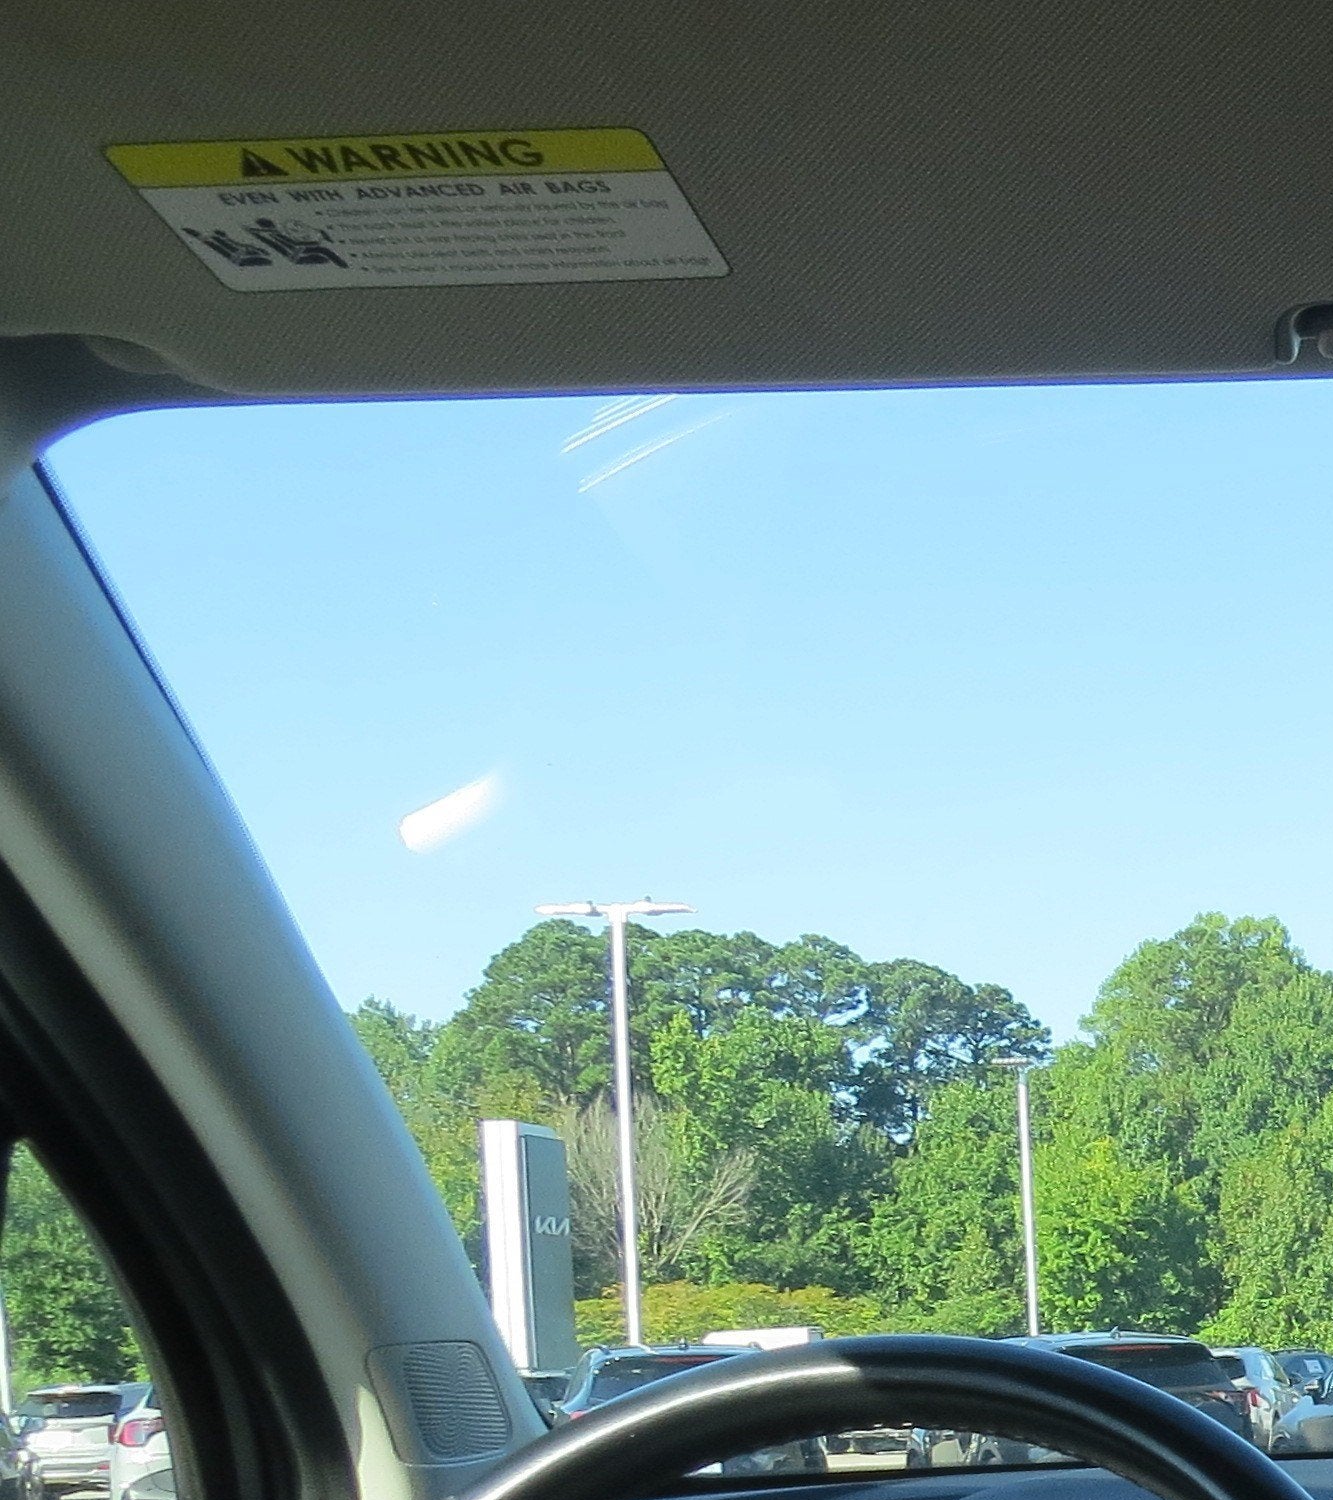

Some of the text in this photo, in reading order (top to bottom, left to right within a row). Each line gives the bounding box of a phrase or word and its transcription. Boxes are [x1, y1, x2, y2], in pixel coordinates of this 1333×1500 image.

[284, 139, 545, 174] WARNING
[219, 179, 611, 205] EVEN WITH ADVANCED AIR BAGS
[535, 1215, 570, 1236] KIA
